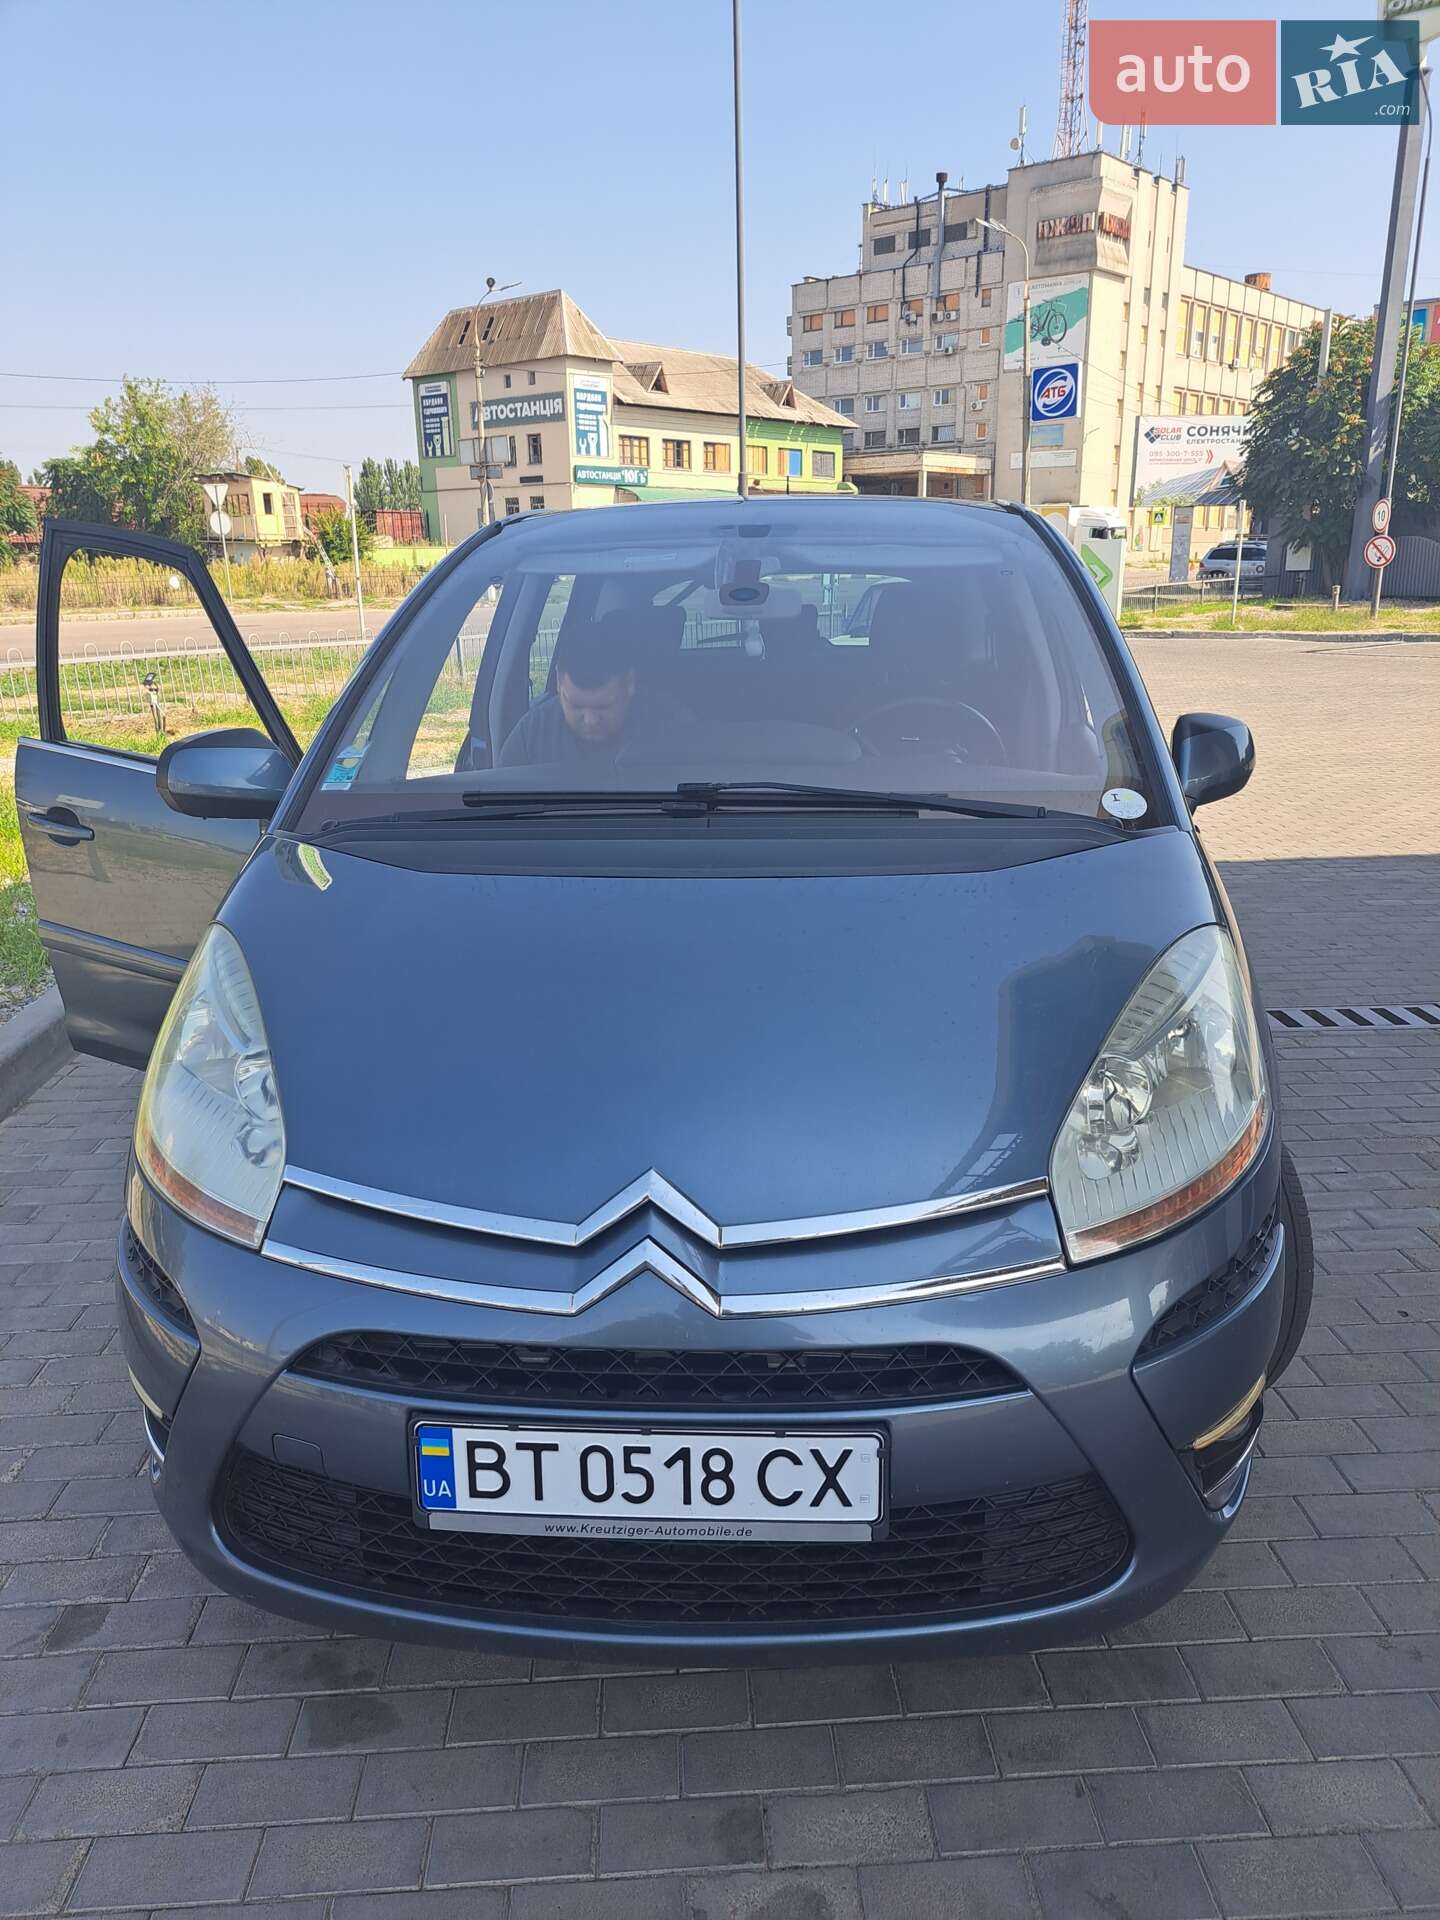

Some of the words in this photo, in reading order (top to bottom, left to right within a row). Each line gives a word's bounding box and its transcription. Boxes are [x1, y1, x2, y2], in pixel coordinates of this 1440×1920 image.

[1154, 426, 1183, 434] SOLAR
[1160, 433, 1182, 441] CLUB
[1377, 510, 1386, 523] 10
[466, 1439, 560, 1503] BT
[579, 1444, 736, 1507] 0518
[757, 1447, 854, 1508] CX
[423, 1479, 452, 1498] UA
[544, 1522, 753, 1538] www.Kreutziger-Automobile.de
